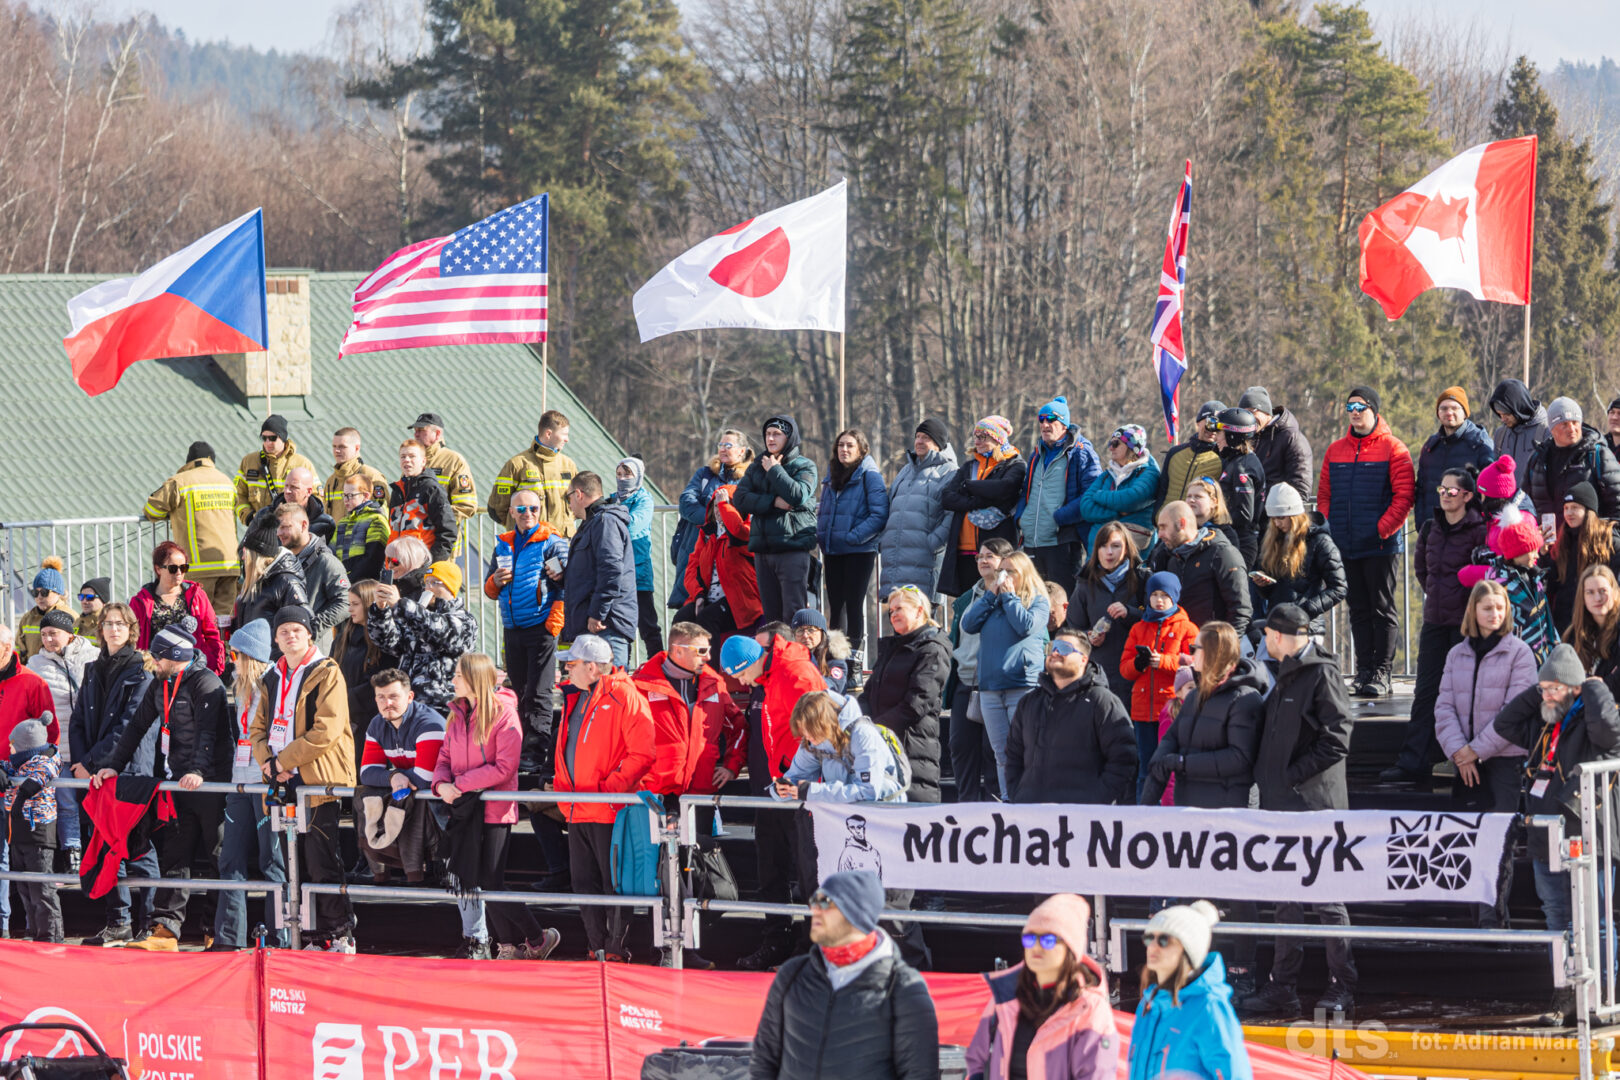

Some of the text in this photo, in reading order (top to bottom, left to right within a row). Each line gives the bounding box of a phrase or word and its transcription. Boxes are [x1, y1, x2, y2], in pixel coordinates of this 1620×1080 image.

[1390, 812, 1485, 835] MN
[903, 813, 1367, 887] Michał Nowaczyk
[270, 987, 306, 1001] POLSKI
[270, 1001, 306, 1015] MISTRZ
[620, 1003, 663, 1019] POLSKI
[620, 1015, 663, 1031] MISTRZ
[138, 1032, 203, 1061] POLSKIE
[377, 1025, 518, 1080] PFR
